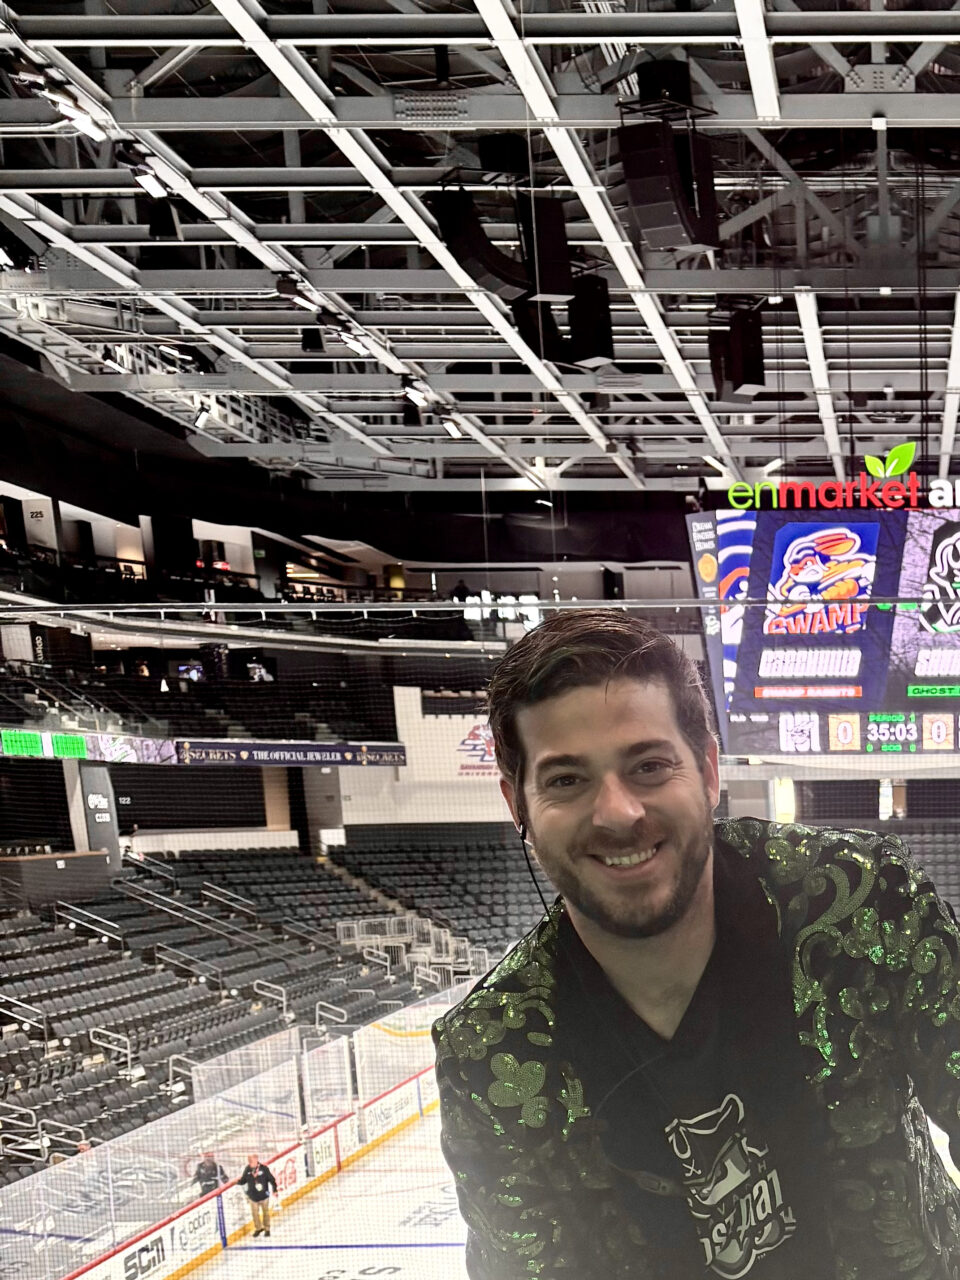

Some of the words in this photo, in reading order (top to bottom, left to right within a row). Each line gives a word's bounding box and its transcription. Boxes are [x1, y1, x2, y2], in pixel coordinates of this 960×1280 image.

[727, 471, 921, 509] enmarket
[767, 597, 871, 634] SWAMP
[911, 687, 955, 695] GHOST
[837, 721, 853, 745] 0
[866, 723, 918, 741] 35:03
[931, 720, 947, 744] 0
[251, 750, 269, 761] THE
[118, 796, 131, 805] 122
